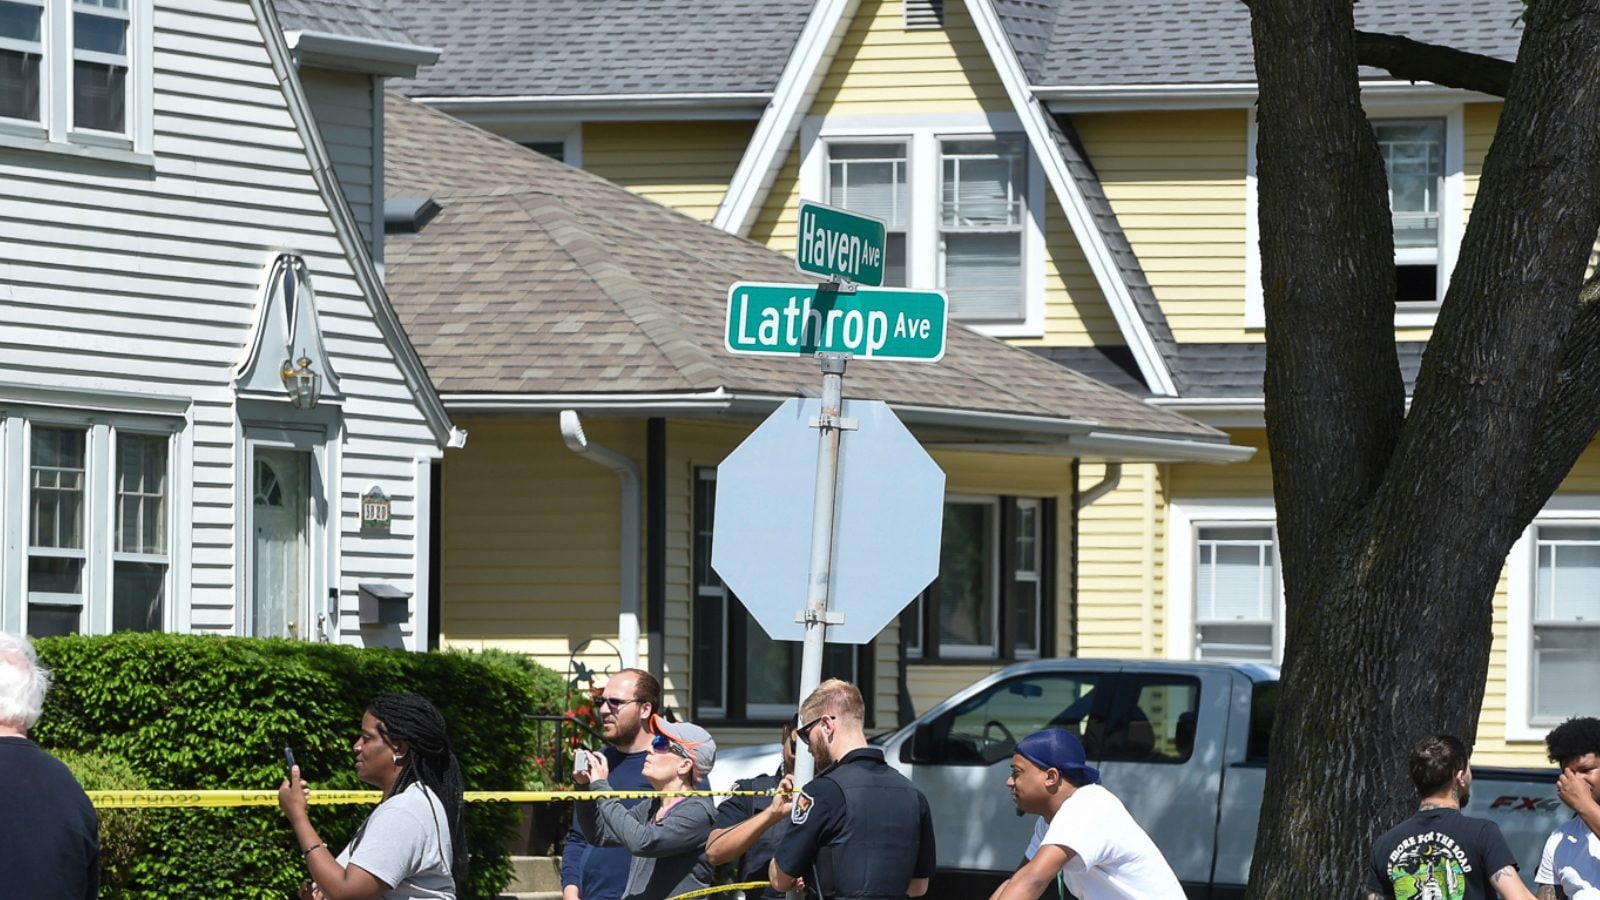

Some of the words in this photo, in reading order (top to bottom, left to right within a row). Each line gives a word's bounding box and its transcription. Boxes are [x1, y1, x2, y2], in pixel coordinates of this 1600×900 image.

[801, 212, 860, 275] Haven
[862, 240, 880, 268] Ave
[737, 293, 888, 357] Lathrop
[893, 311, 931, 339] Ave
[1489, 796, 1562, 811] FX4
[1390, 836, 1417, 862] MORE
[1436, 832, 1455, 849] THE
[1452, 845, 1472, 873] ROAD
